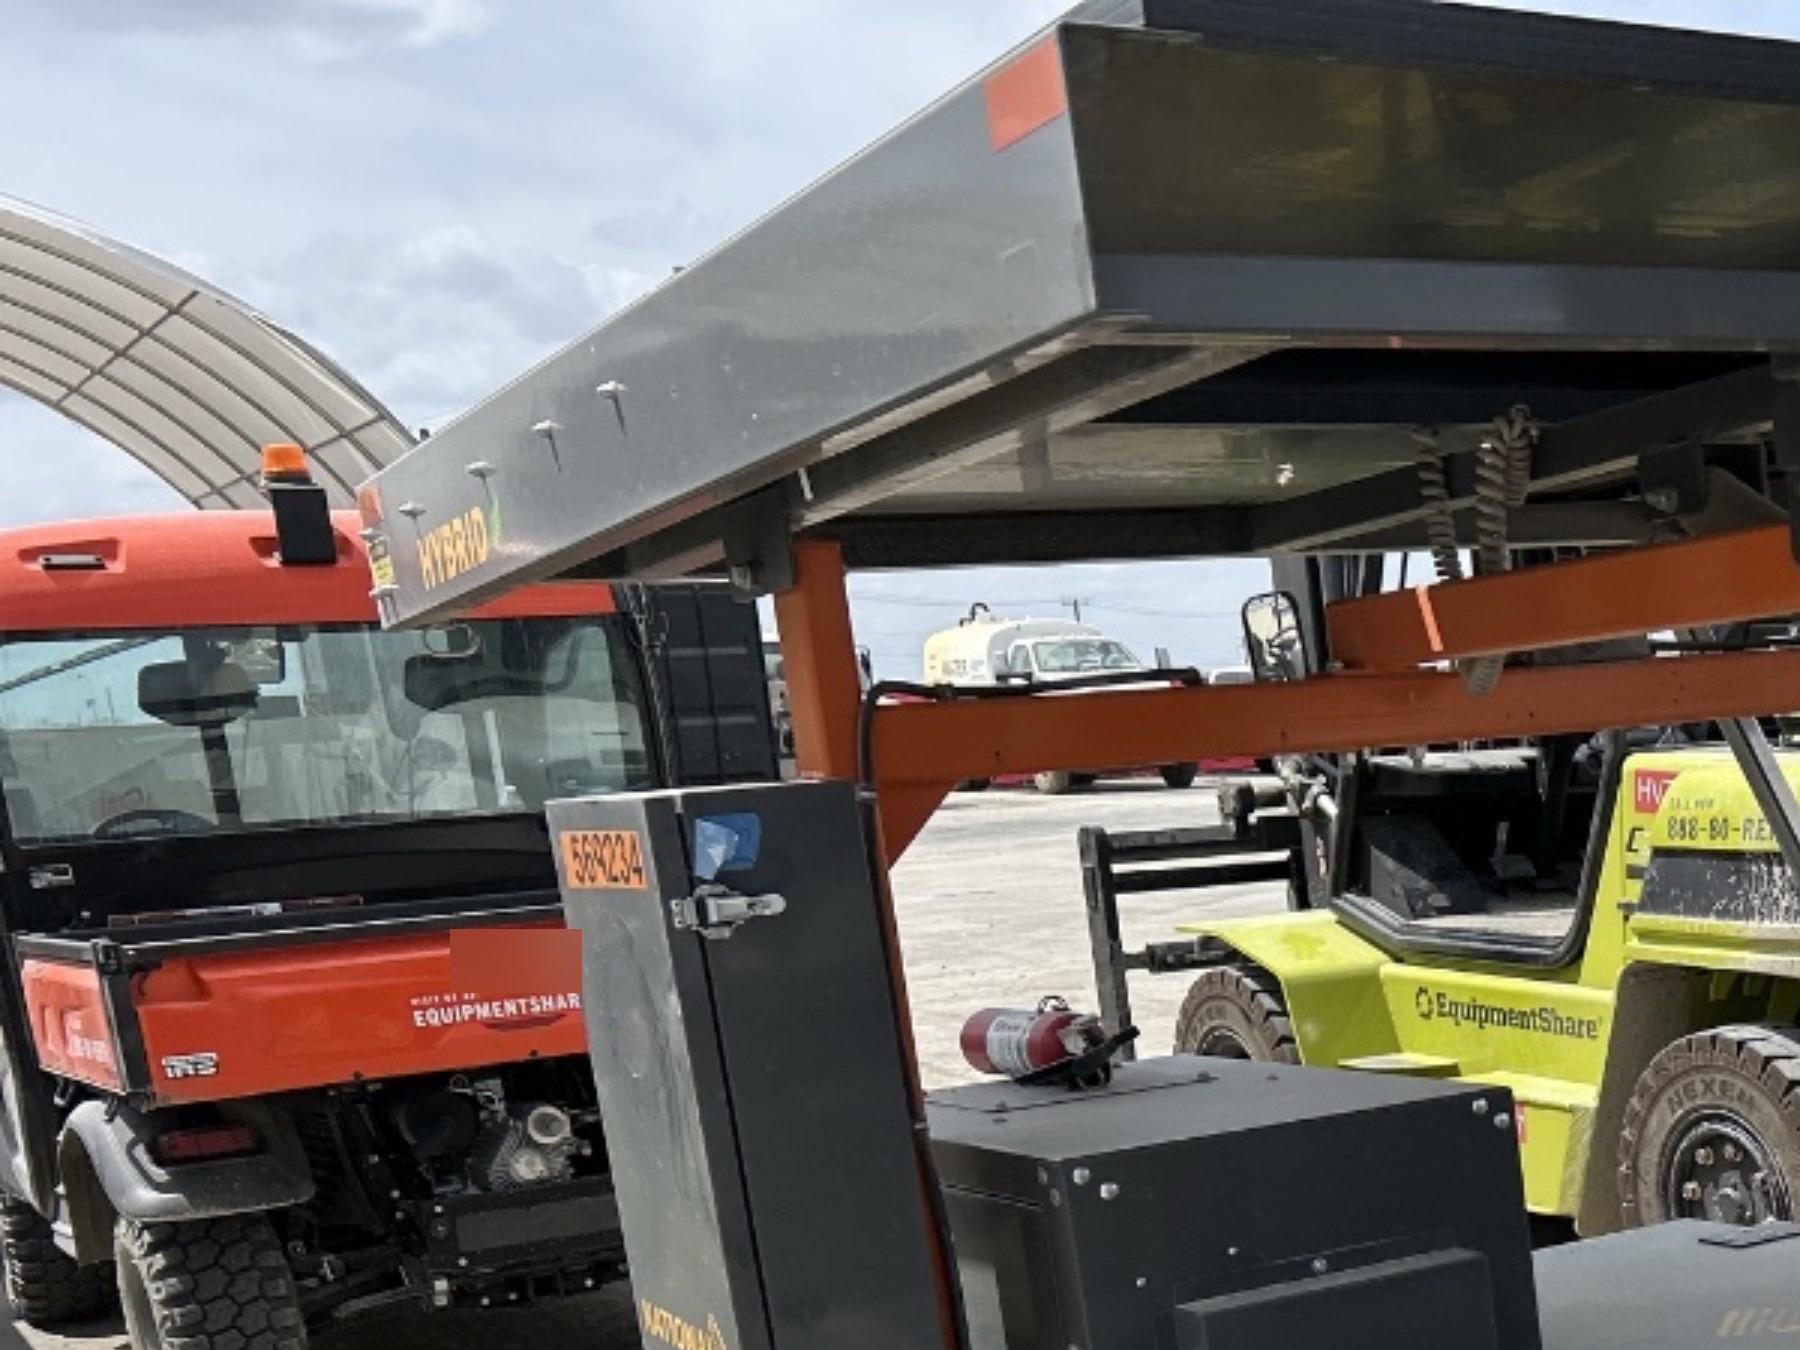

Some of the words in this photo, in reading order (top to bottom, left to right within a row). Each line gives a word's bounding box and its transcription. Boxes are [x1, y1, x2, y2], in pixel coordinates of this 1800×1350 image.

[416, 505, 489, 593] HYBRID
[1667, 814, 1782, 842] 888-80-RE
[1435, 991, 1600, 1040] EquipmentShare
